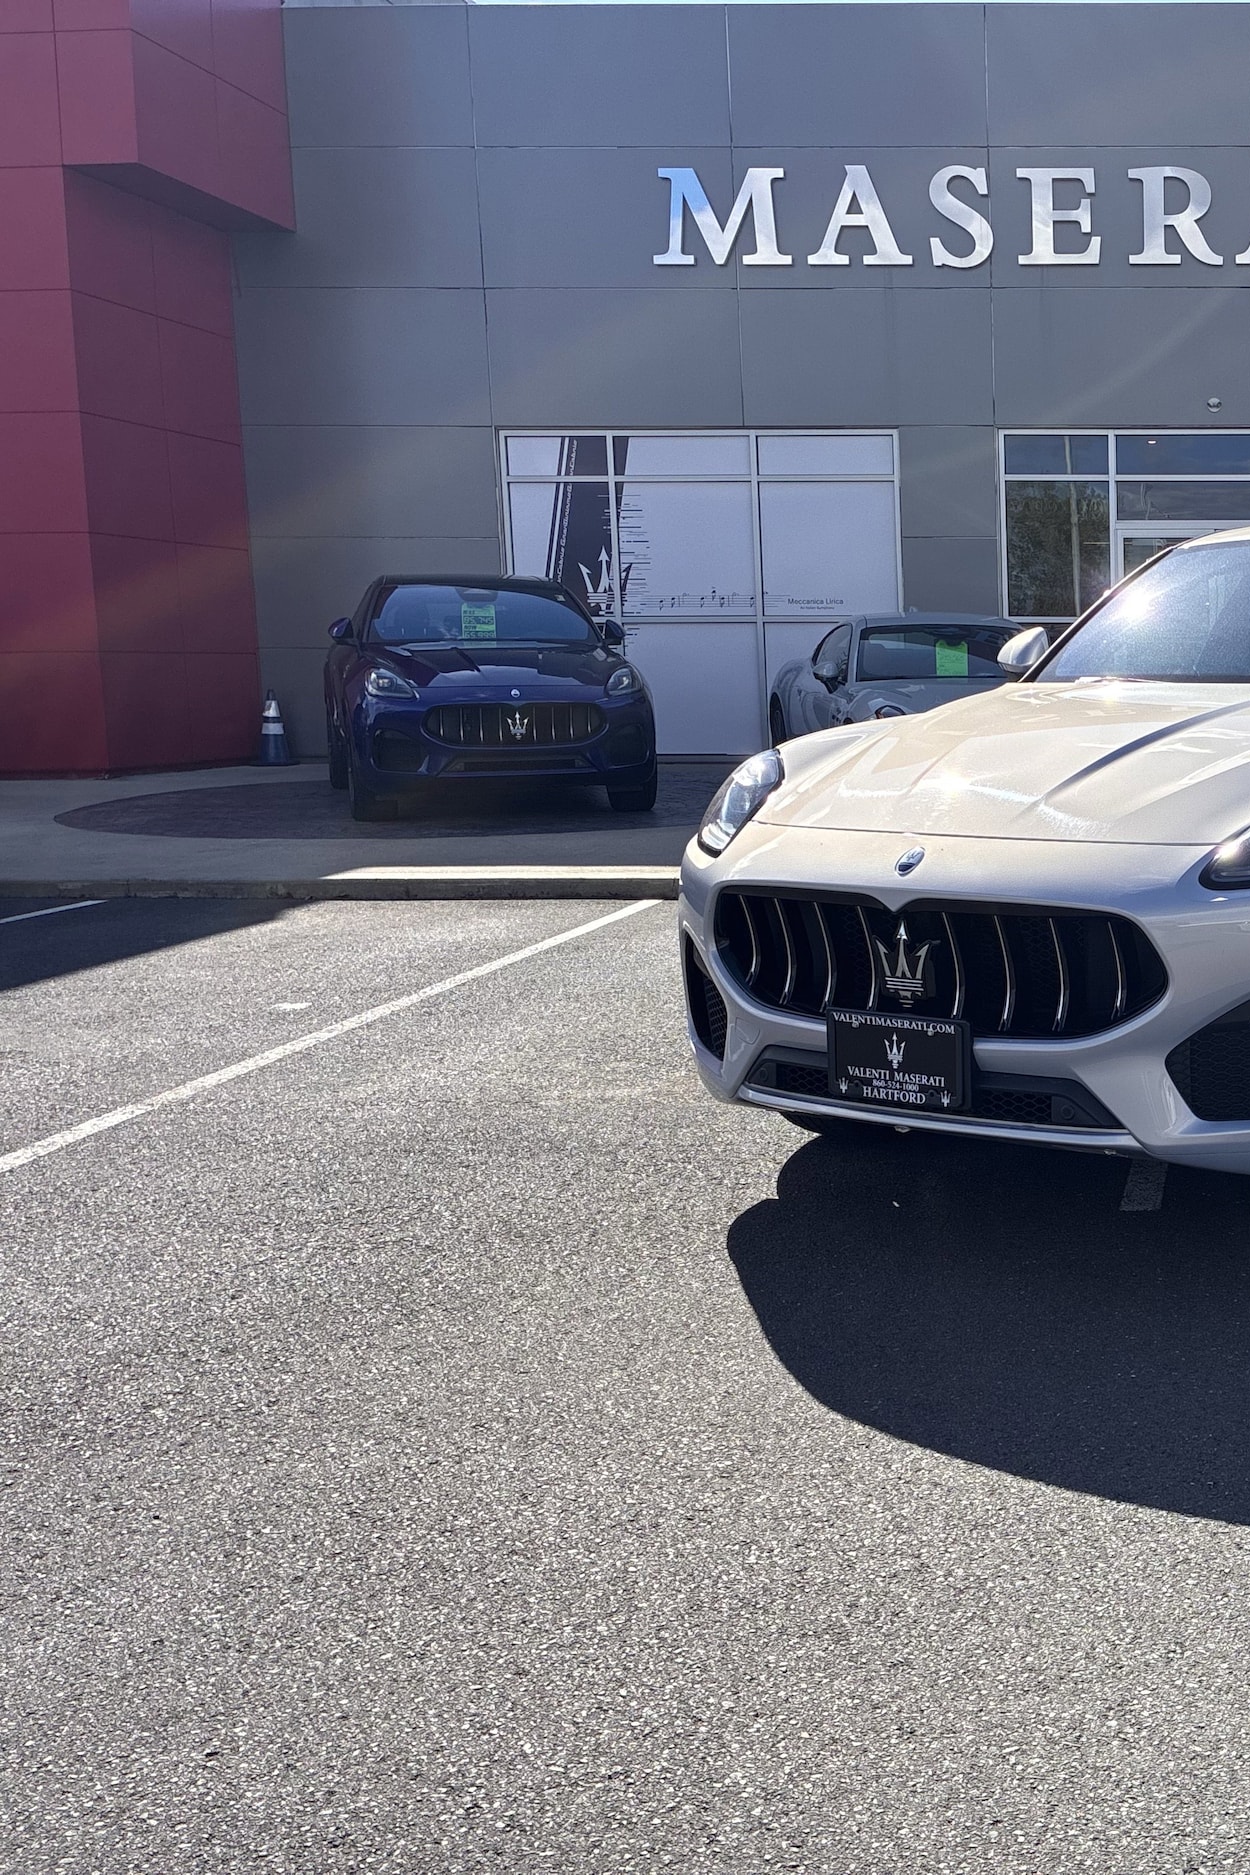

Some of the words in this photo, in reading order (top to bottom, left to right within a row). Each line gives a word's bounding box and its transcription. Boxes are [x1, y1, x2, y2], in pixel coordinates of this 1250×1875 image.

[832, 1012, 955, 1035] VALENTIMASERATI.COM
[847, 1065, 890, 1081] VALENTI
[893, 1071, 945, 1088] MASERATI
[872, 1079, 919, 1092] 860-524-1000
[862, 1085, 926, 1105] HARTFORD
